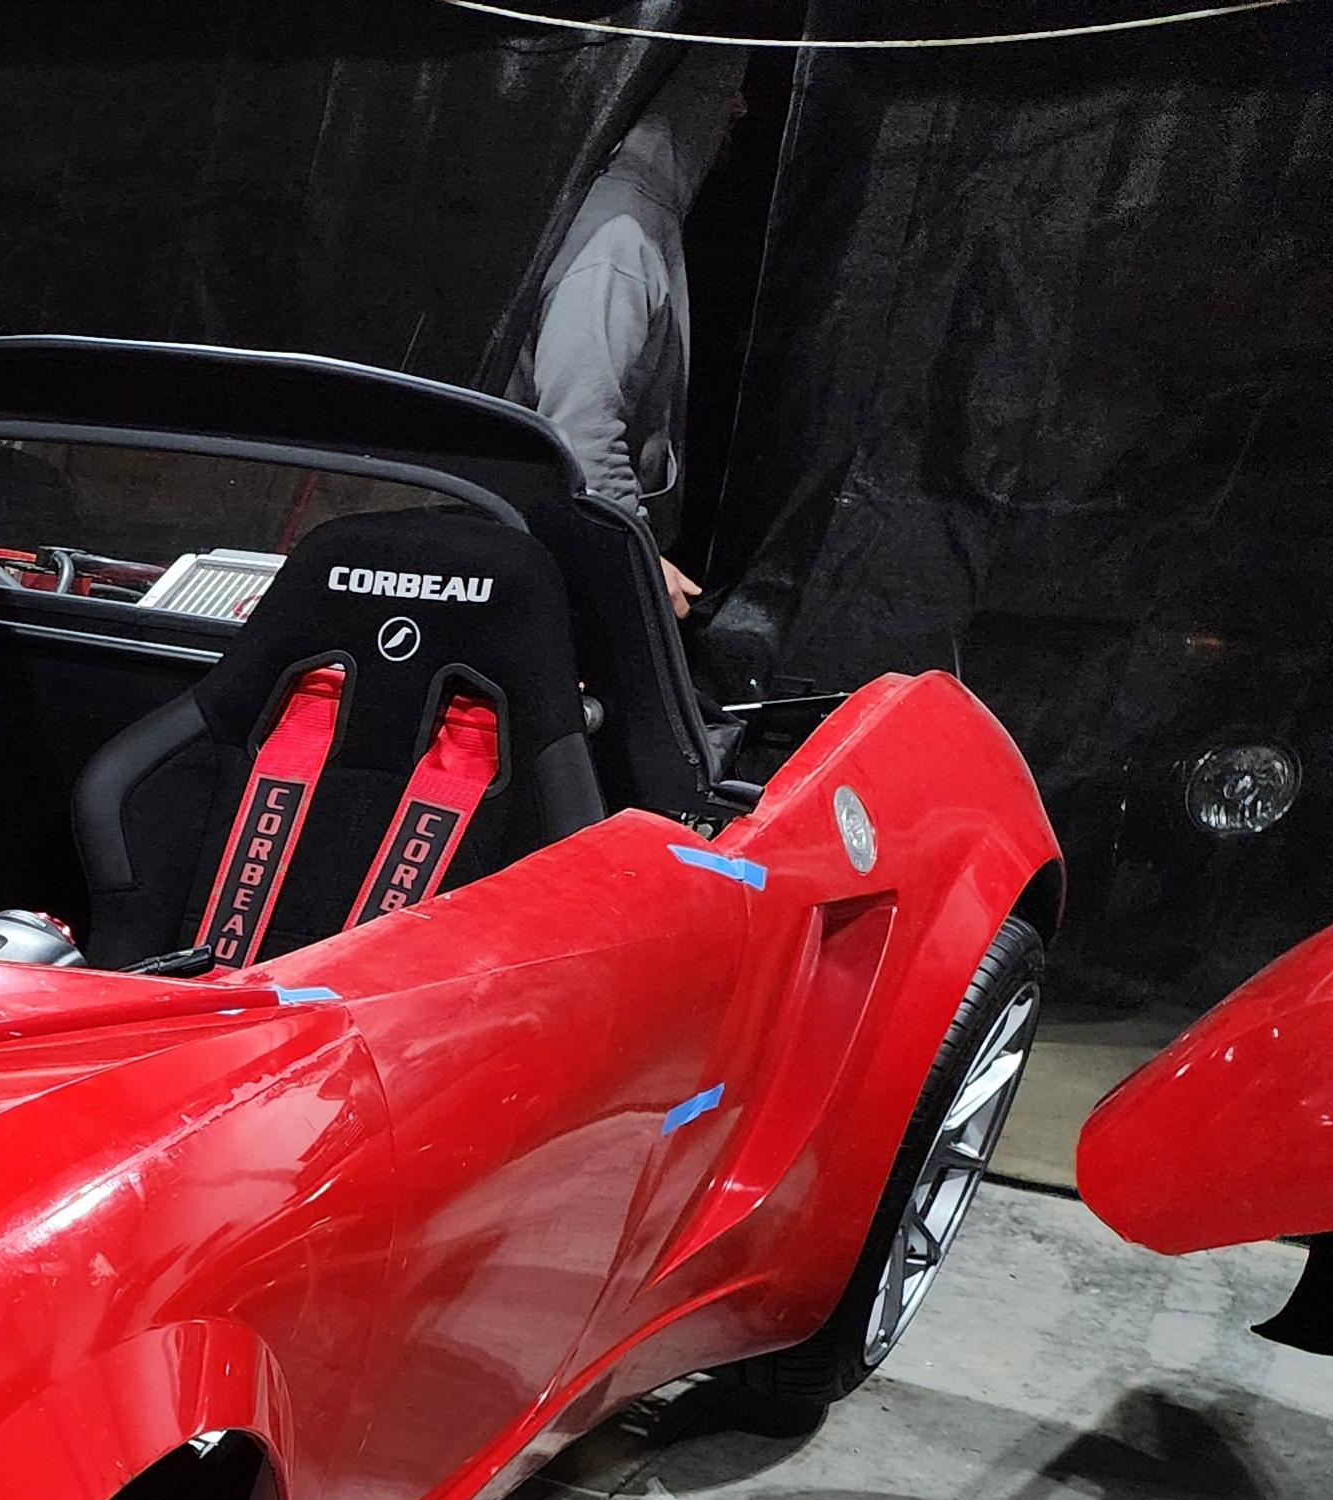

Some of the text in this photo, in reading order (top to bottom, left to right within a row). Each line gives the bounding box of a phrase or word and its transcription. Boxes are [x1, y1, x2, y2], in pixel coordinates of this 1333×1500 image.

[327, 565, 495, 603] CORBEAU
[214, 787, 291, 961] CORBEAU
[377, 812, 443, 914] CORB
